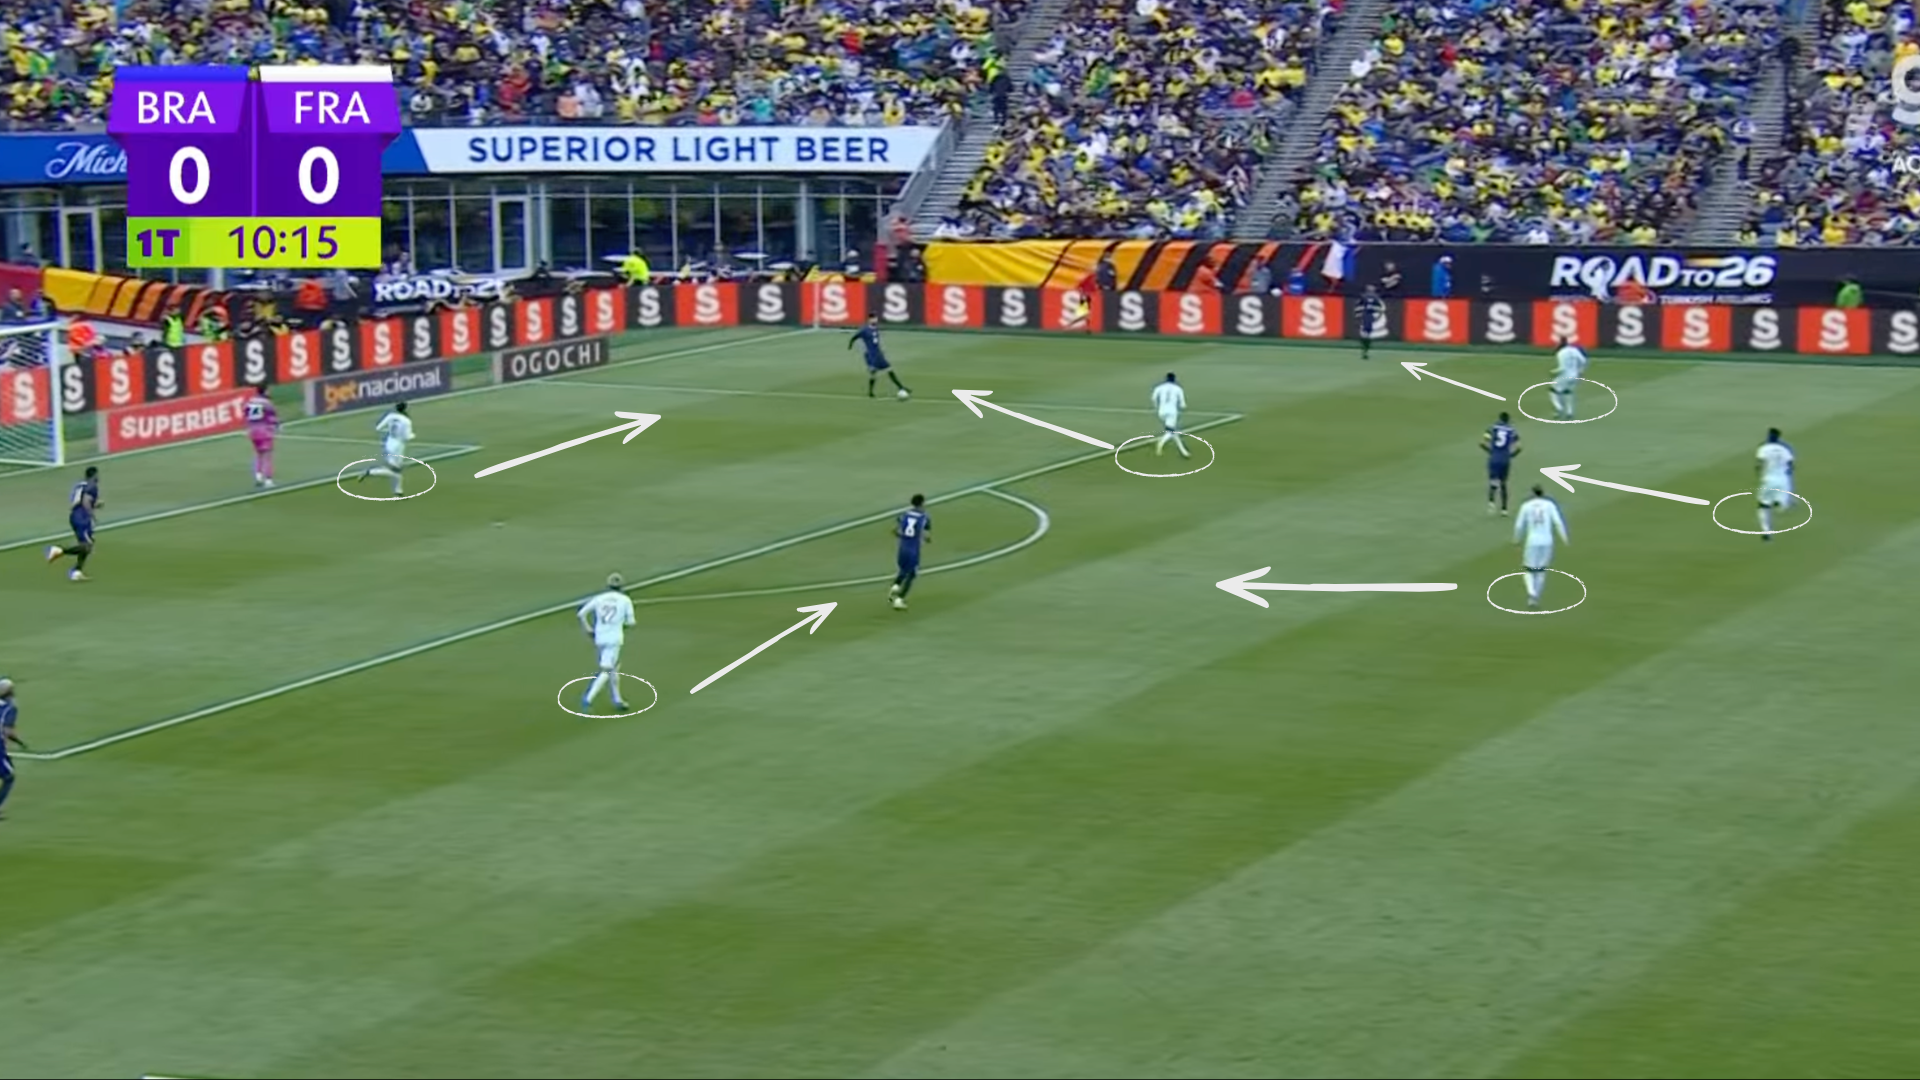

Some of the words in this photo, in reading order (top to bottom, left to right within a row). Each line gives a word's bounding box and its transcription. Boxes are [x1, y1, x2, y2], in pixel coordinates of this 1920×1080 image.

[468, 136, 656, 163] SUPERIOR
[672, 136, 780, 163] LIGHT
[796, 136, 890, 163] BEER
[1550, 256, 1681, 289] ROAD
[374, 278, 452, 302] ROAD
[511, 341, 600, 378] OGOCHI
[324, 366, 441, 412] betnacional
[119, 396, 247, 440] SUPERBET
[1494, 429, 1508, 448] 5
[905, 516, 918, 538] 8
